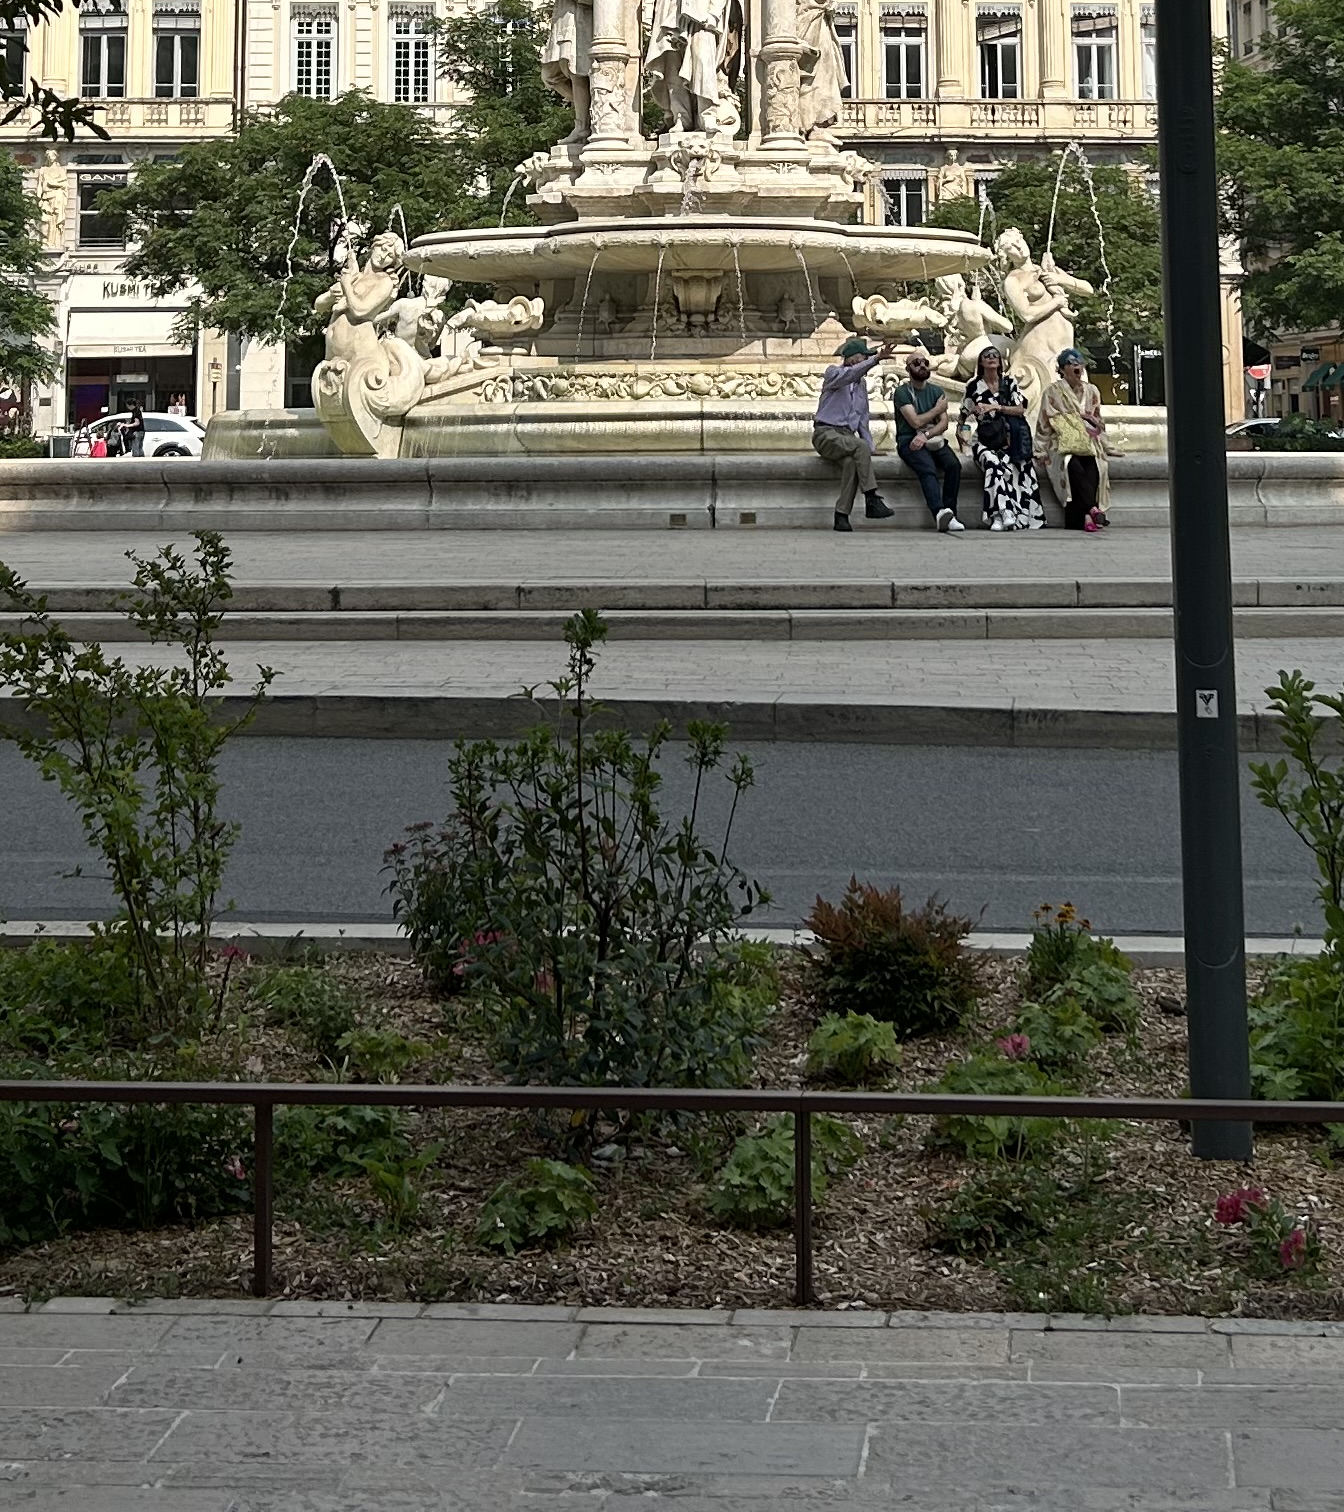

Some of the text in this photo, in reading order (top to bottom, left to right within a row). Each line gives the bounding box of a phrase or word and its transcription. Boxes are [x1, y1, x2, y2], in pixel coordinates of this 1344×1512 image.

[79, 173, 126, 182] GANT
[102, 281, 140, 299] KUSMI
[134, 345, 147, 353] TEA
